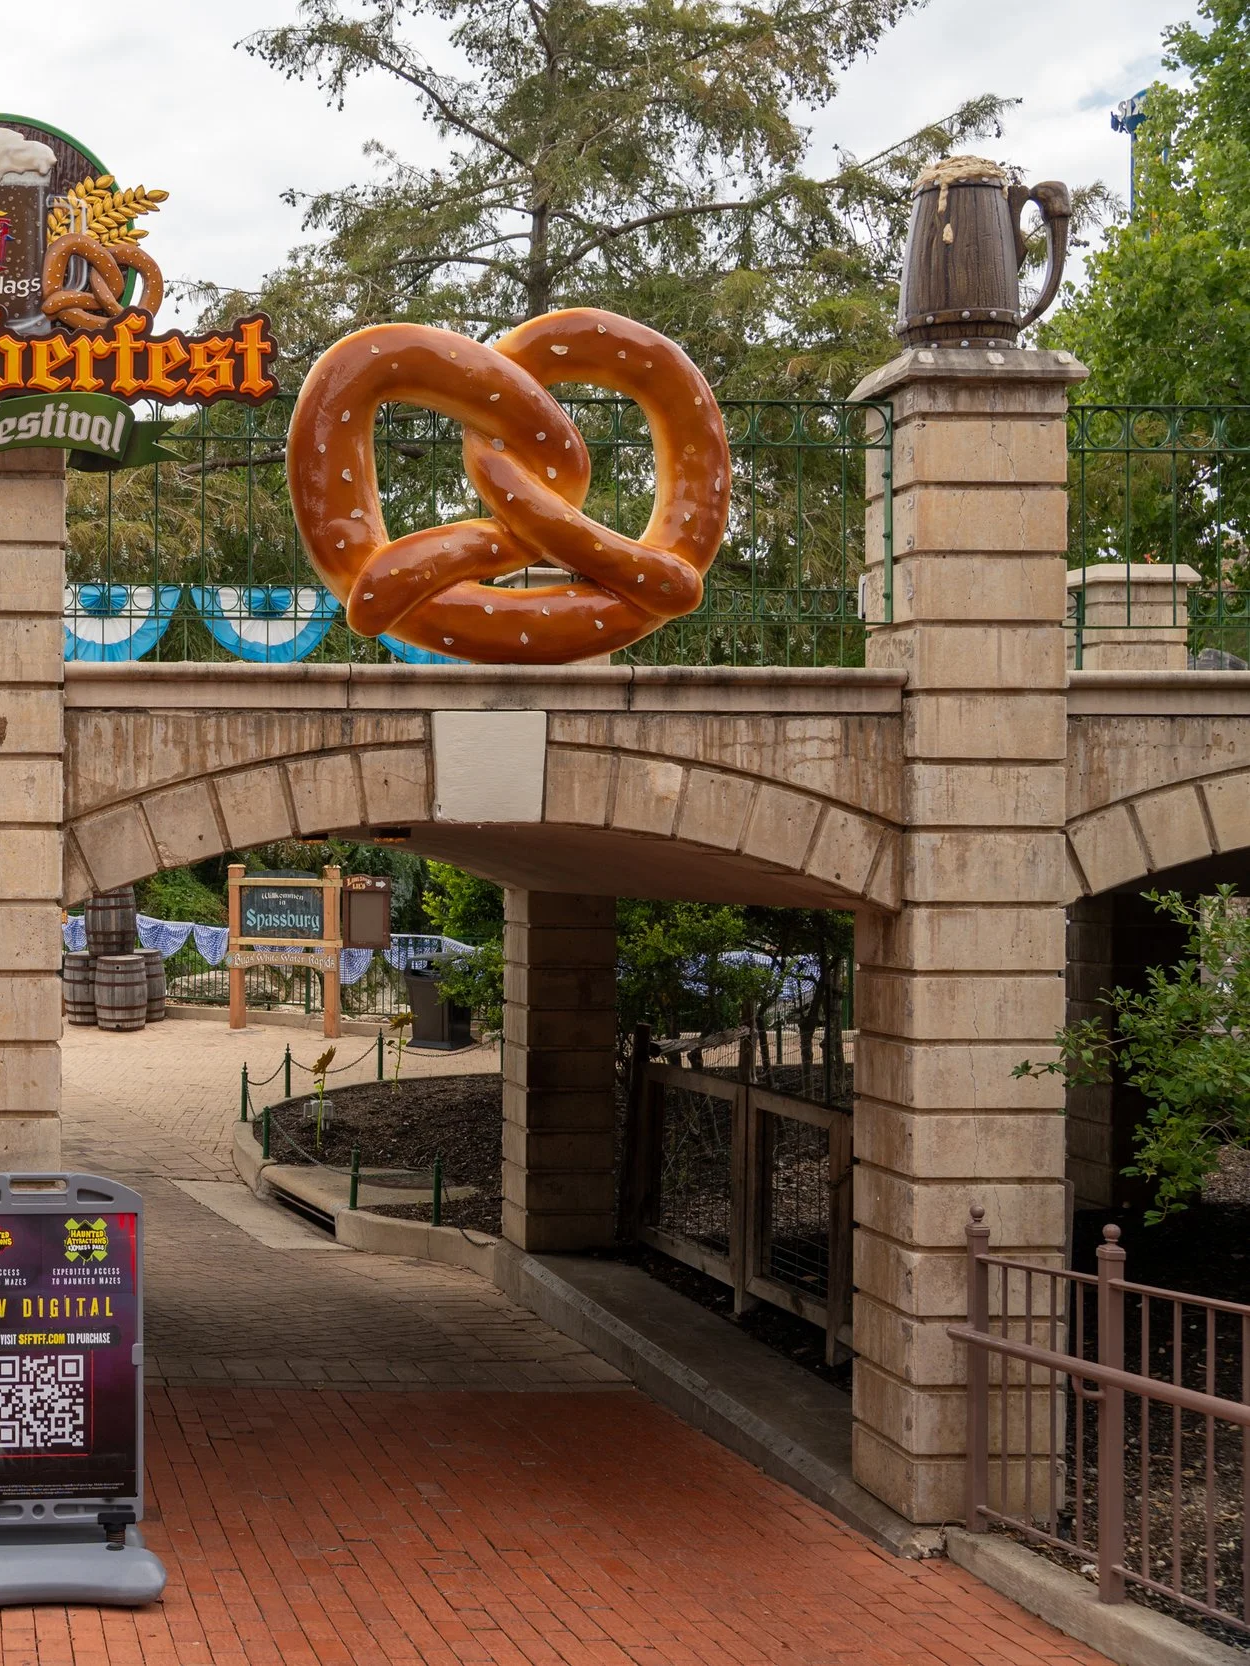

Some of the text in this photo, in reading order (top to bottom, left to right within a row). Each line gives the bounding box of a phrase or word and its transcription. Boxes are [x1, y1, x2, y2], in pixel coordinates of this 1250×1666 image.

[261, 892, 304, 901] Willkommen
[246, 908, 320, 931] Spassburg
[281, 953, 304, 963] Water
[308, 954, 335, 969] Rapids
[70, 1230, 104, 1238] HAUNTED
[66, 1237, 107, 1246] ATTRACTIONS
[52, 1267, 120, 1276] EXPEDITED ACCESS
[5, 1278, 27, 1286] MAZES
[52, 1277, 121, 1285] TO HAUNTED MAZES
[22, 1296, 113, 1318] DIGITAL
[0, 1334, 17, 1344] VISIT
[67, 1333, 75, 1343] TO
[76, 1332, 110, 1344] PURCHASE
